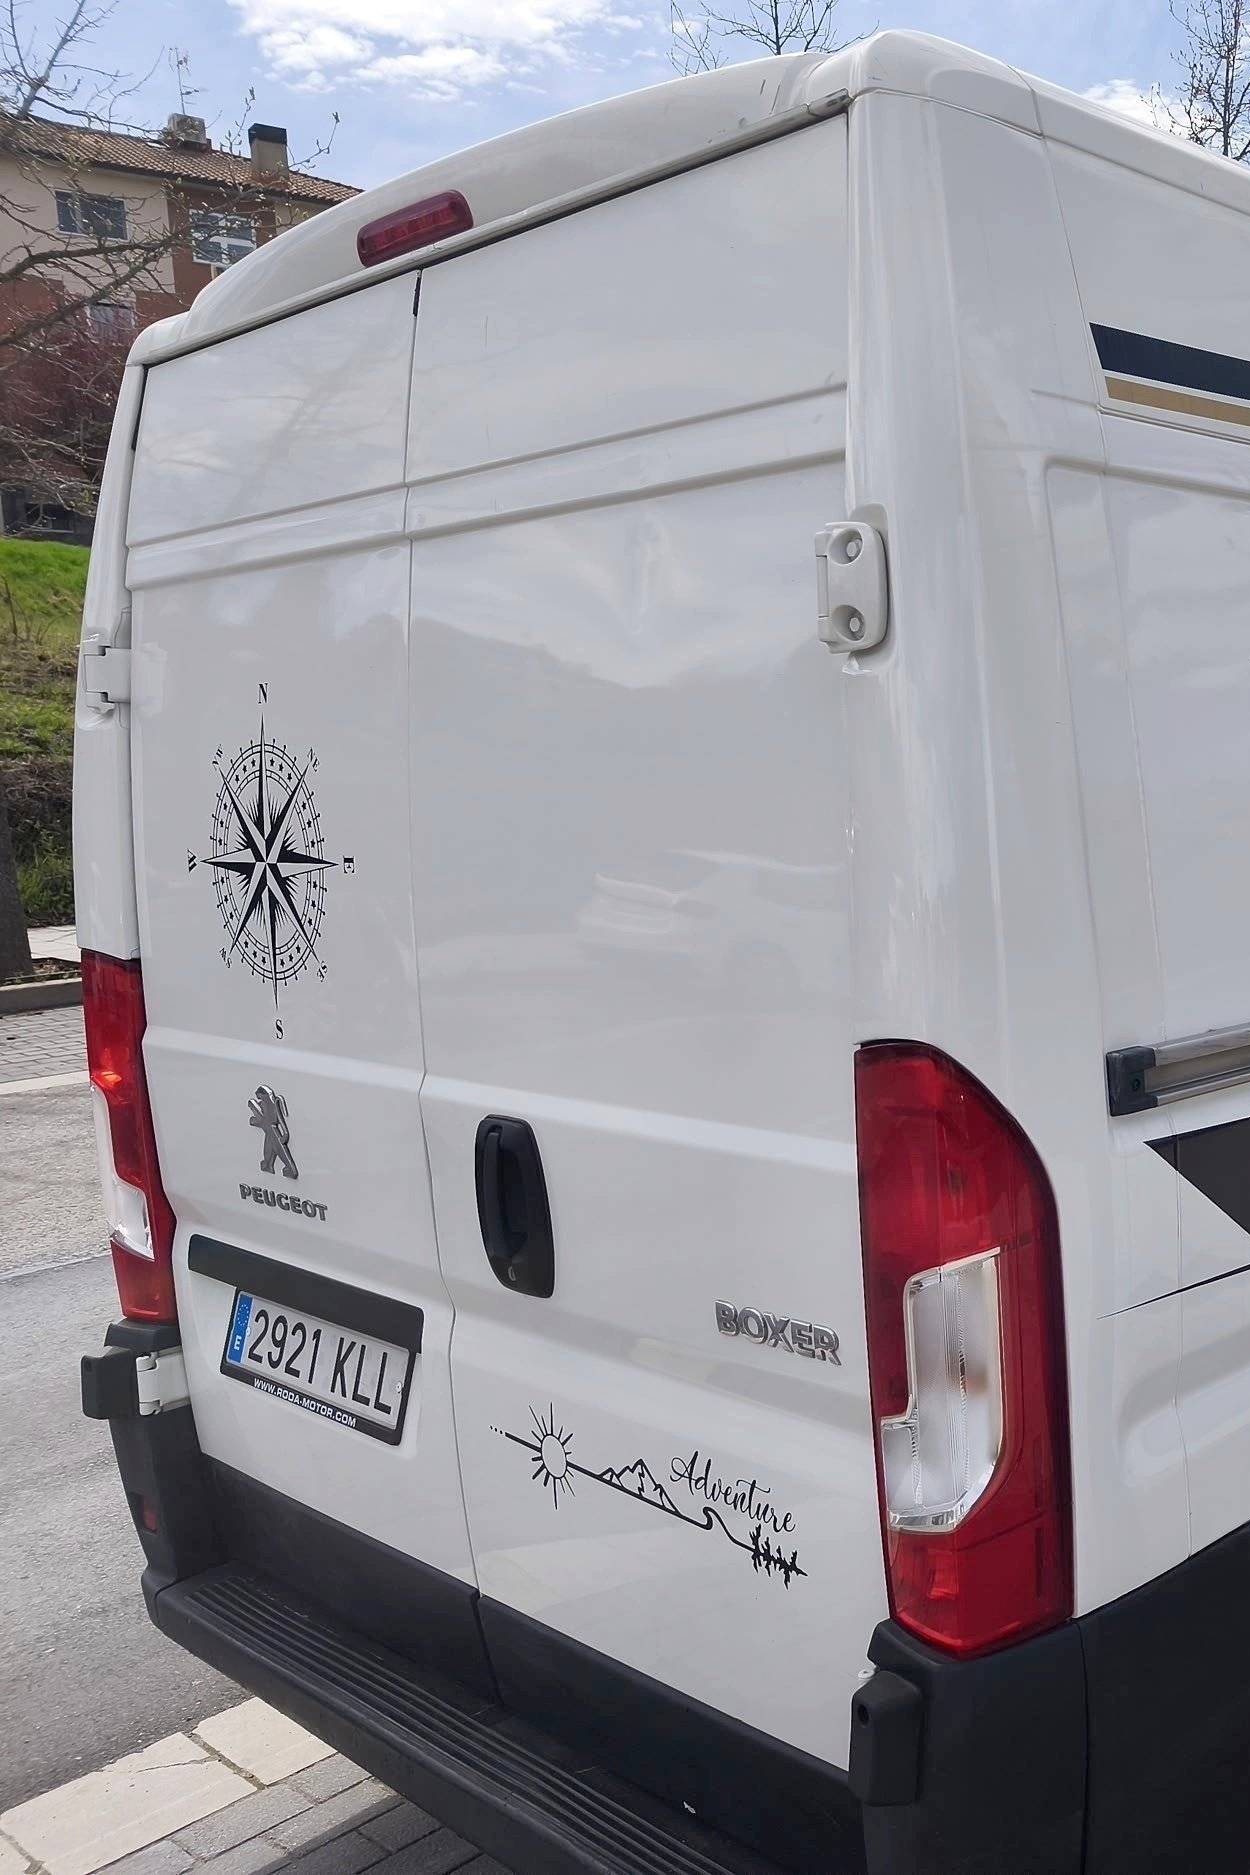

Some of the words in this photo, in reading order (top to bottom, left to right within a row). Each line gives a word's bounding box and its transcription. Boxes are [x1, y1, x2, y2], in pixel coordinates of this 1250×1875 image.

[257, 682, 269, 704] N
[274, 1019, 285, 1040] S
[239, 1183, 328, 1222] PEUGEOT
[714, 1299, 843, 1366] BOXER
[247, 1309, 322, 1385] 2921
[330, 1336, 393, 1416] KLL
[253, 1377, 357, 1428] WWW.RODA-MOTOR.COM
[669, 1450, 796, 1533] Adventure
